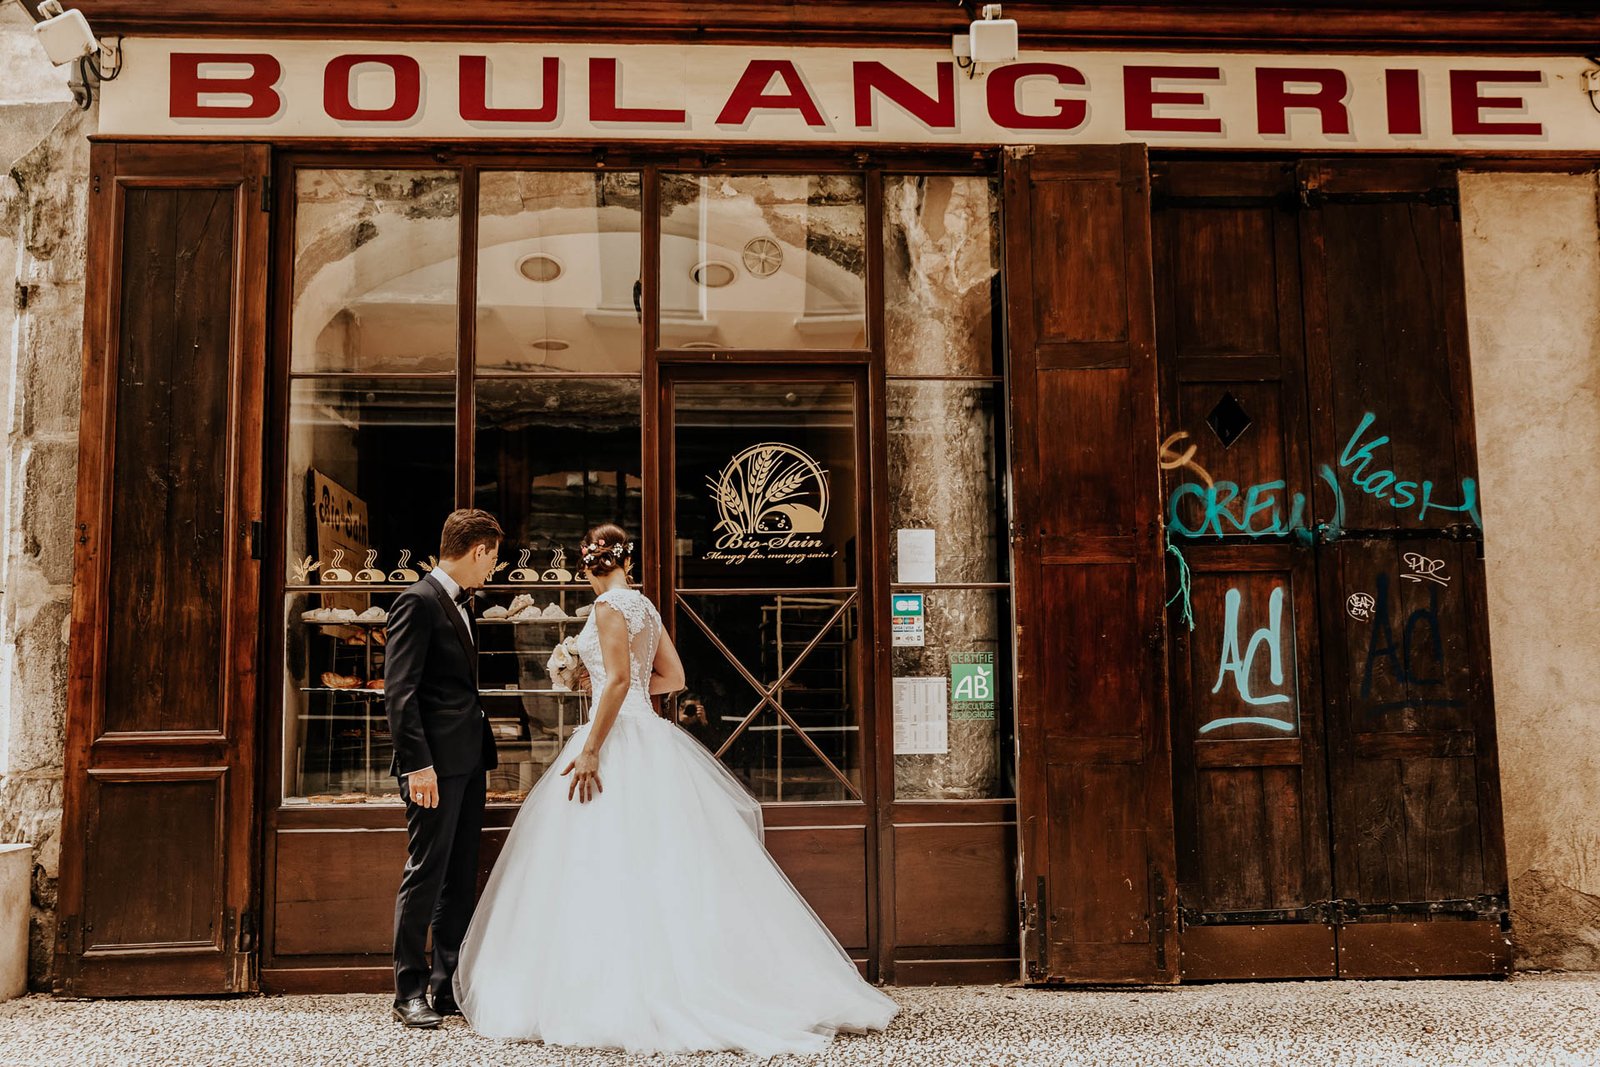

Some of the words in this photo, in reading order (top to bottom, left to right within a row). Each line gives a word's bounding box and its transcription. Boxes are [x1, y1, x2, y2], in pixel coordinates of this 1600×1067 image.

[169, 52, 1543, 136] BOULANGERIE
[715, 531, 823, 550] Bio-Sain
[702, 551, 745, 565] Mangez
[767, 553, 806, 564] mangez
[954, 675, 989, 699] AB
